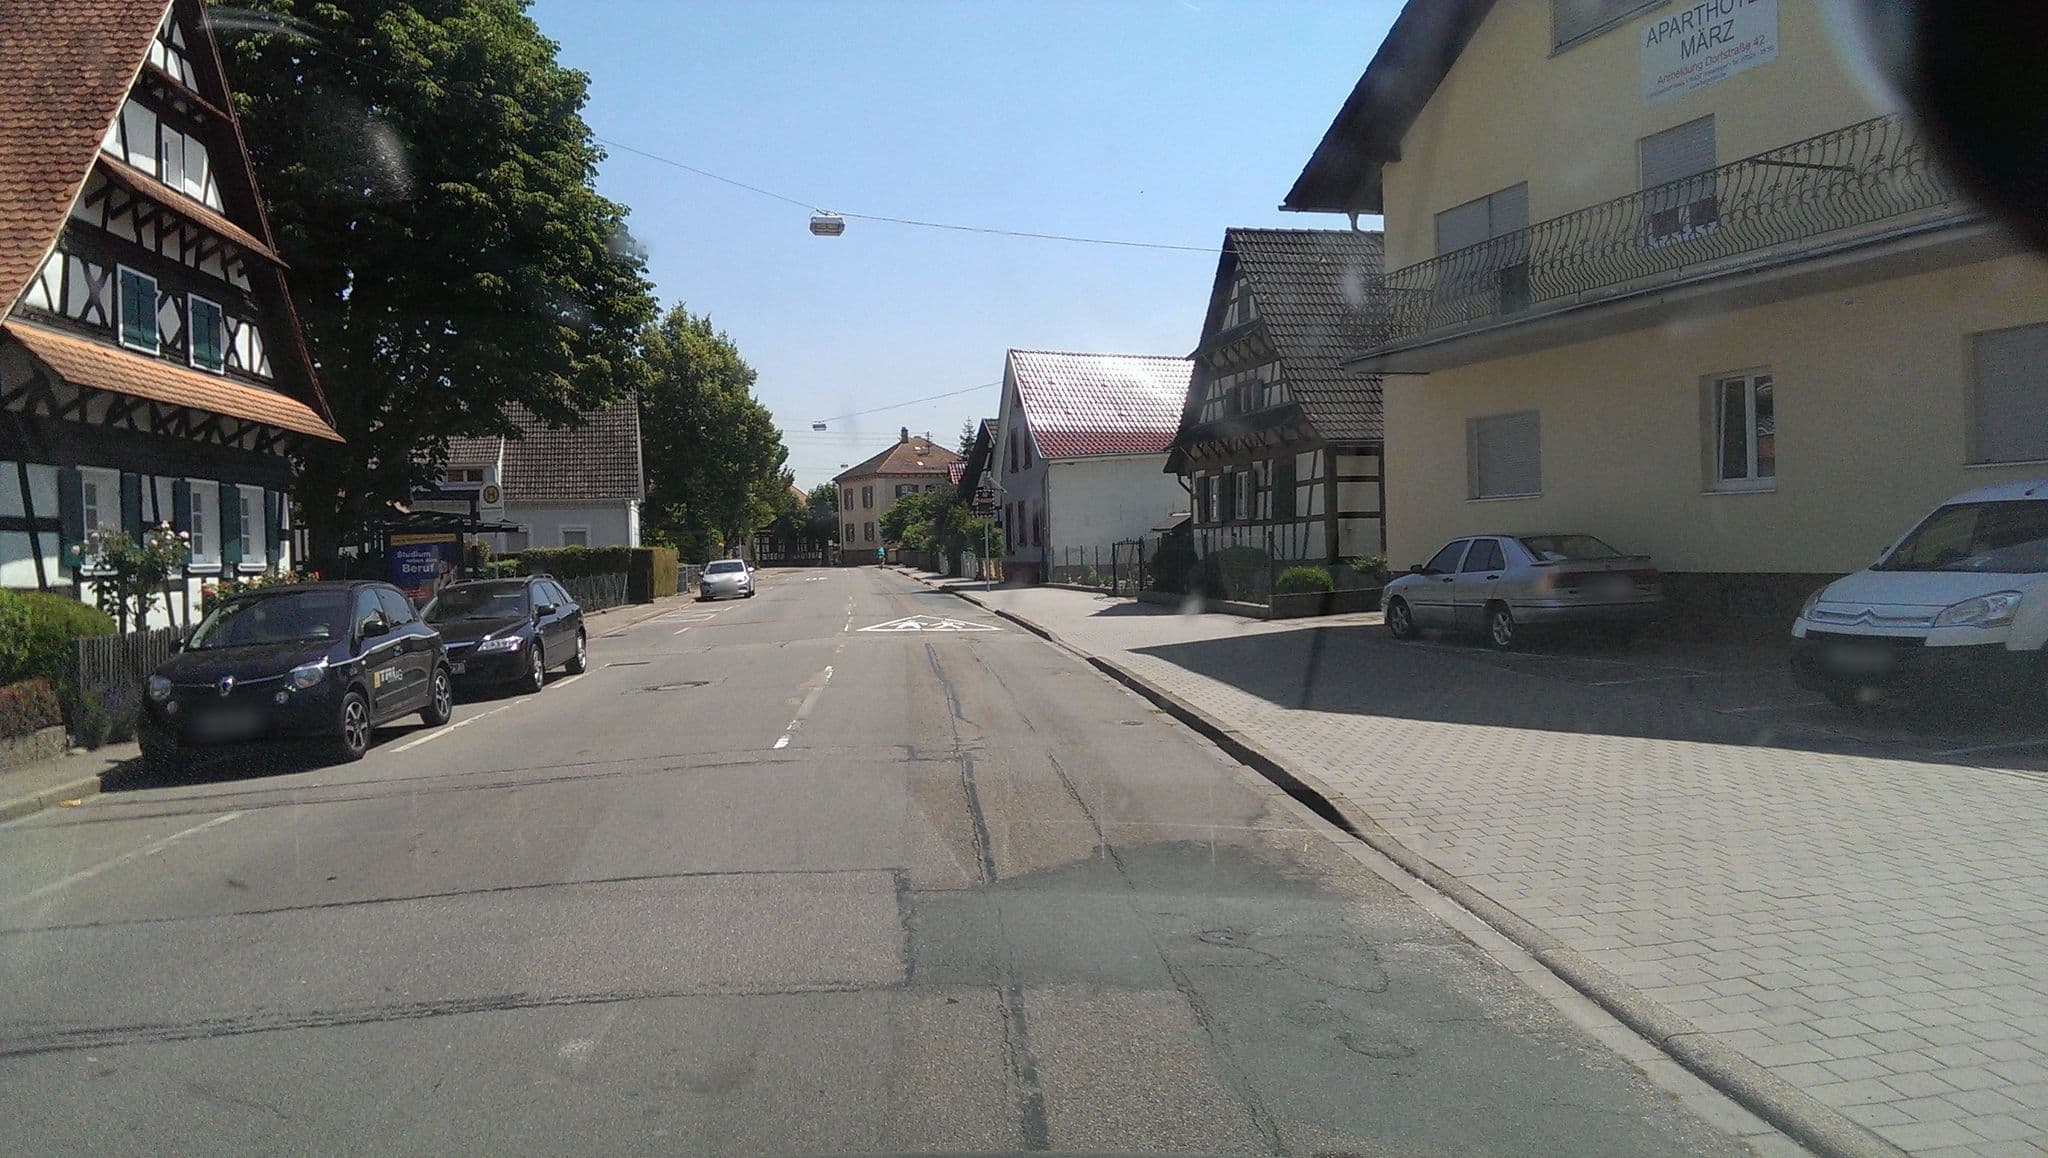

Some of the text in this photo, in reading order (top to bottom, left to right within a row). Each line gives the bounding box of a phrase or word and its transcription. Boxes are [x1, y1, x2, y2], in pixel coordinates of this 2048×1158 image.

[1646, 0, 1758, 48] APARTHO
[1680, 19, 1735, 60] MÄRZ
[1657, 60, 1703, 85] Anmeldung
[1705, 41, 1751, 67] Dorfstraße
[1753, 35, 1766, 48] 42
[396, 550, 431, 559] Studium
[402, 563, 435, 574] Beruf
